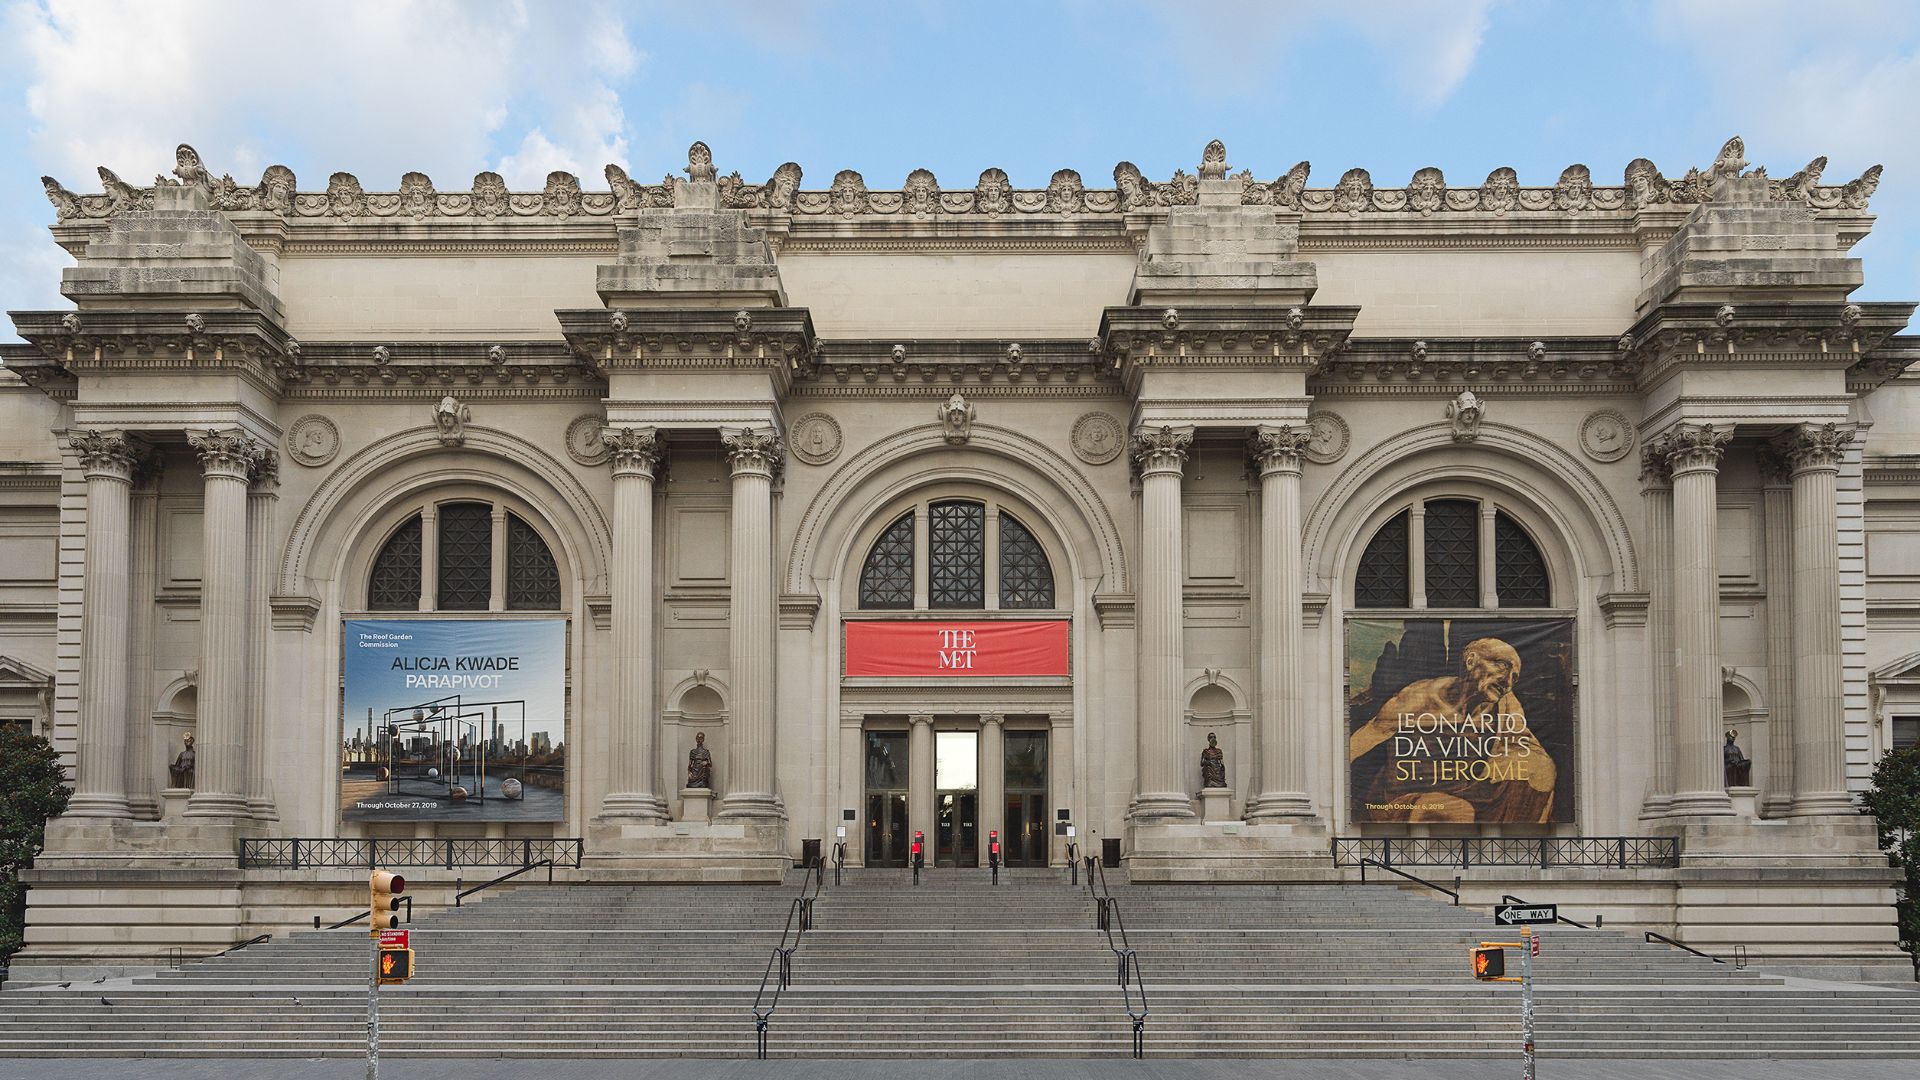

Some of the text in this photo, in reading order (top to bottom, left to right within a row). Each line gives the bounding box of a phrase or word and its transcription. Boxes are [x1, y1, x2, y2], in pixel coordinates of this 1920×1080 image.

[938, 629, 976, 649] THE
[391, 656, 520, 671] ALICJA KWADE
[938, 650, 977, 669] MET
[405, 674, 503, 689] PARAPIVOT
[1397, 712, 1528, 734] LEONARDO
[1395, 736, 1531, 758] DA VINCI'S
[1396, 759, 1530, 786] ST. JEROME
[356, 802, 384, 810] Through
[1365, 803, 1393, 811] Through
[1504, 909, 1550, 920] ONE WAY
